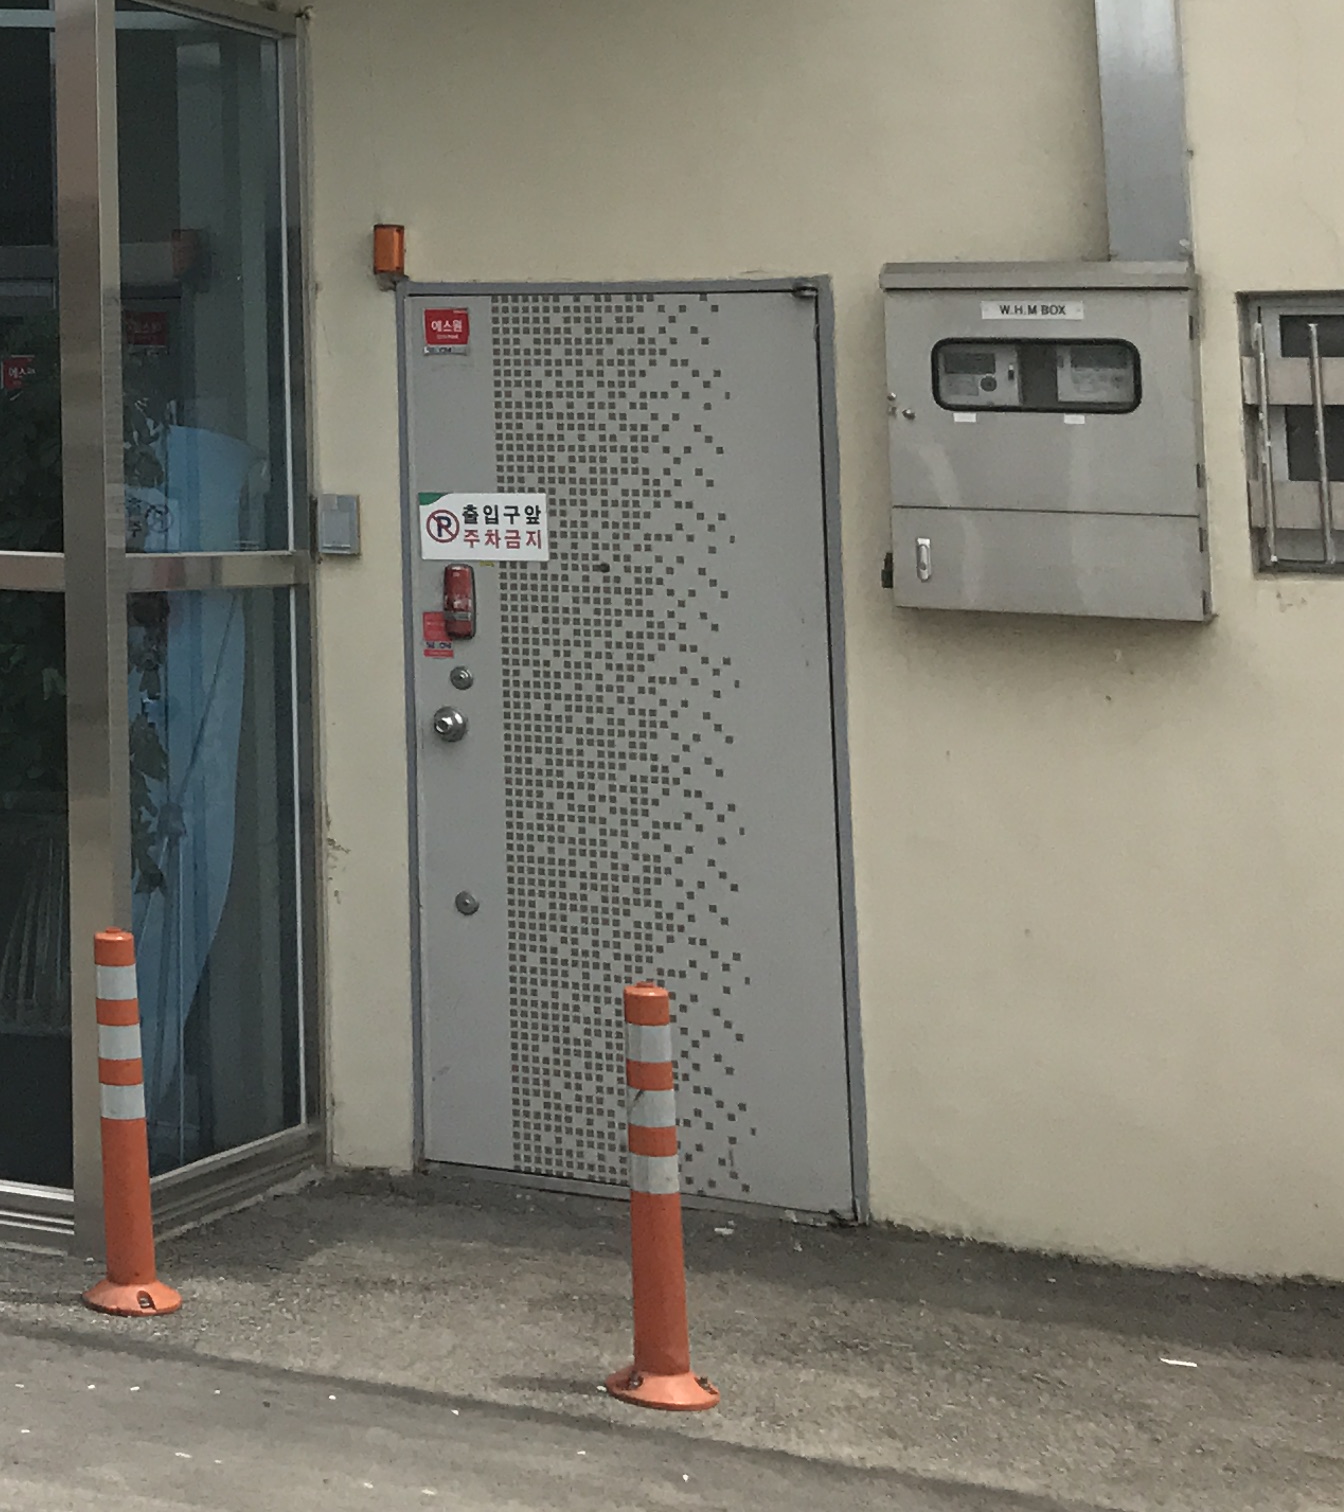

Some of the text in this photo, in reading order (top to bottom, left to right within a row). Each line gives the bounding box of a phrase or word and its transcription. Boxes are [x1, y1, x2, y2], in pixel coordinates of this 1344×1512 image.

[1040, 304, 1067, 316] BOX
[431, 319, 463, 333] 에스원
[462, 504, 542, 526] 출입구앞
[462, 529, 543, 550] 주차금지
